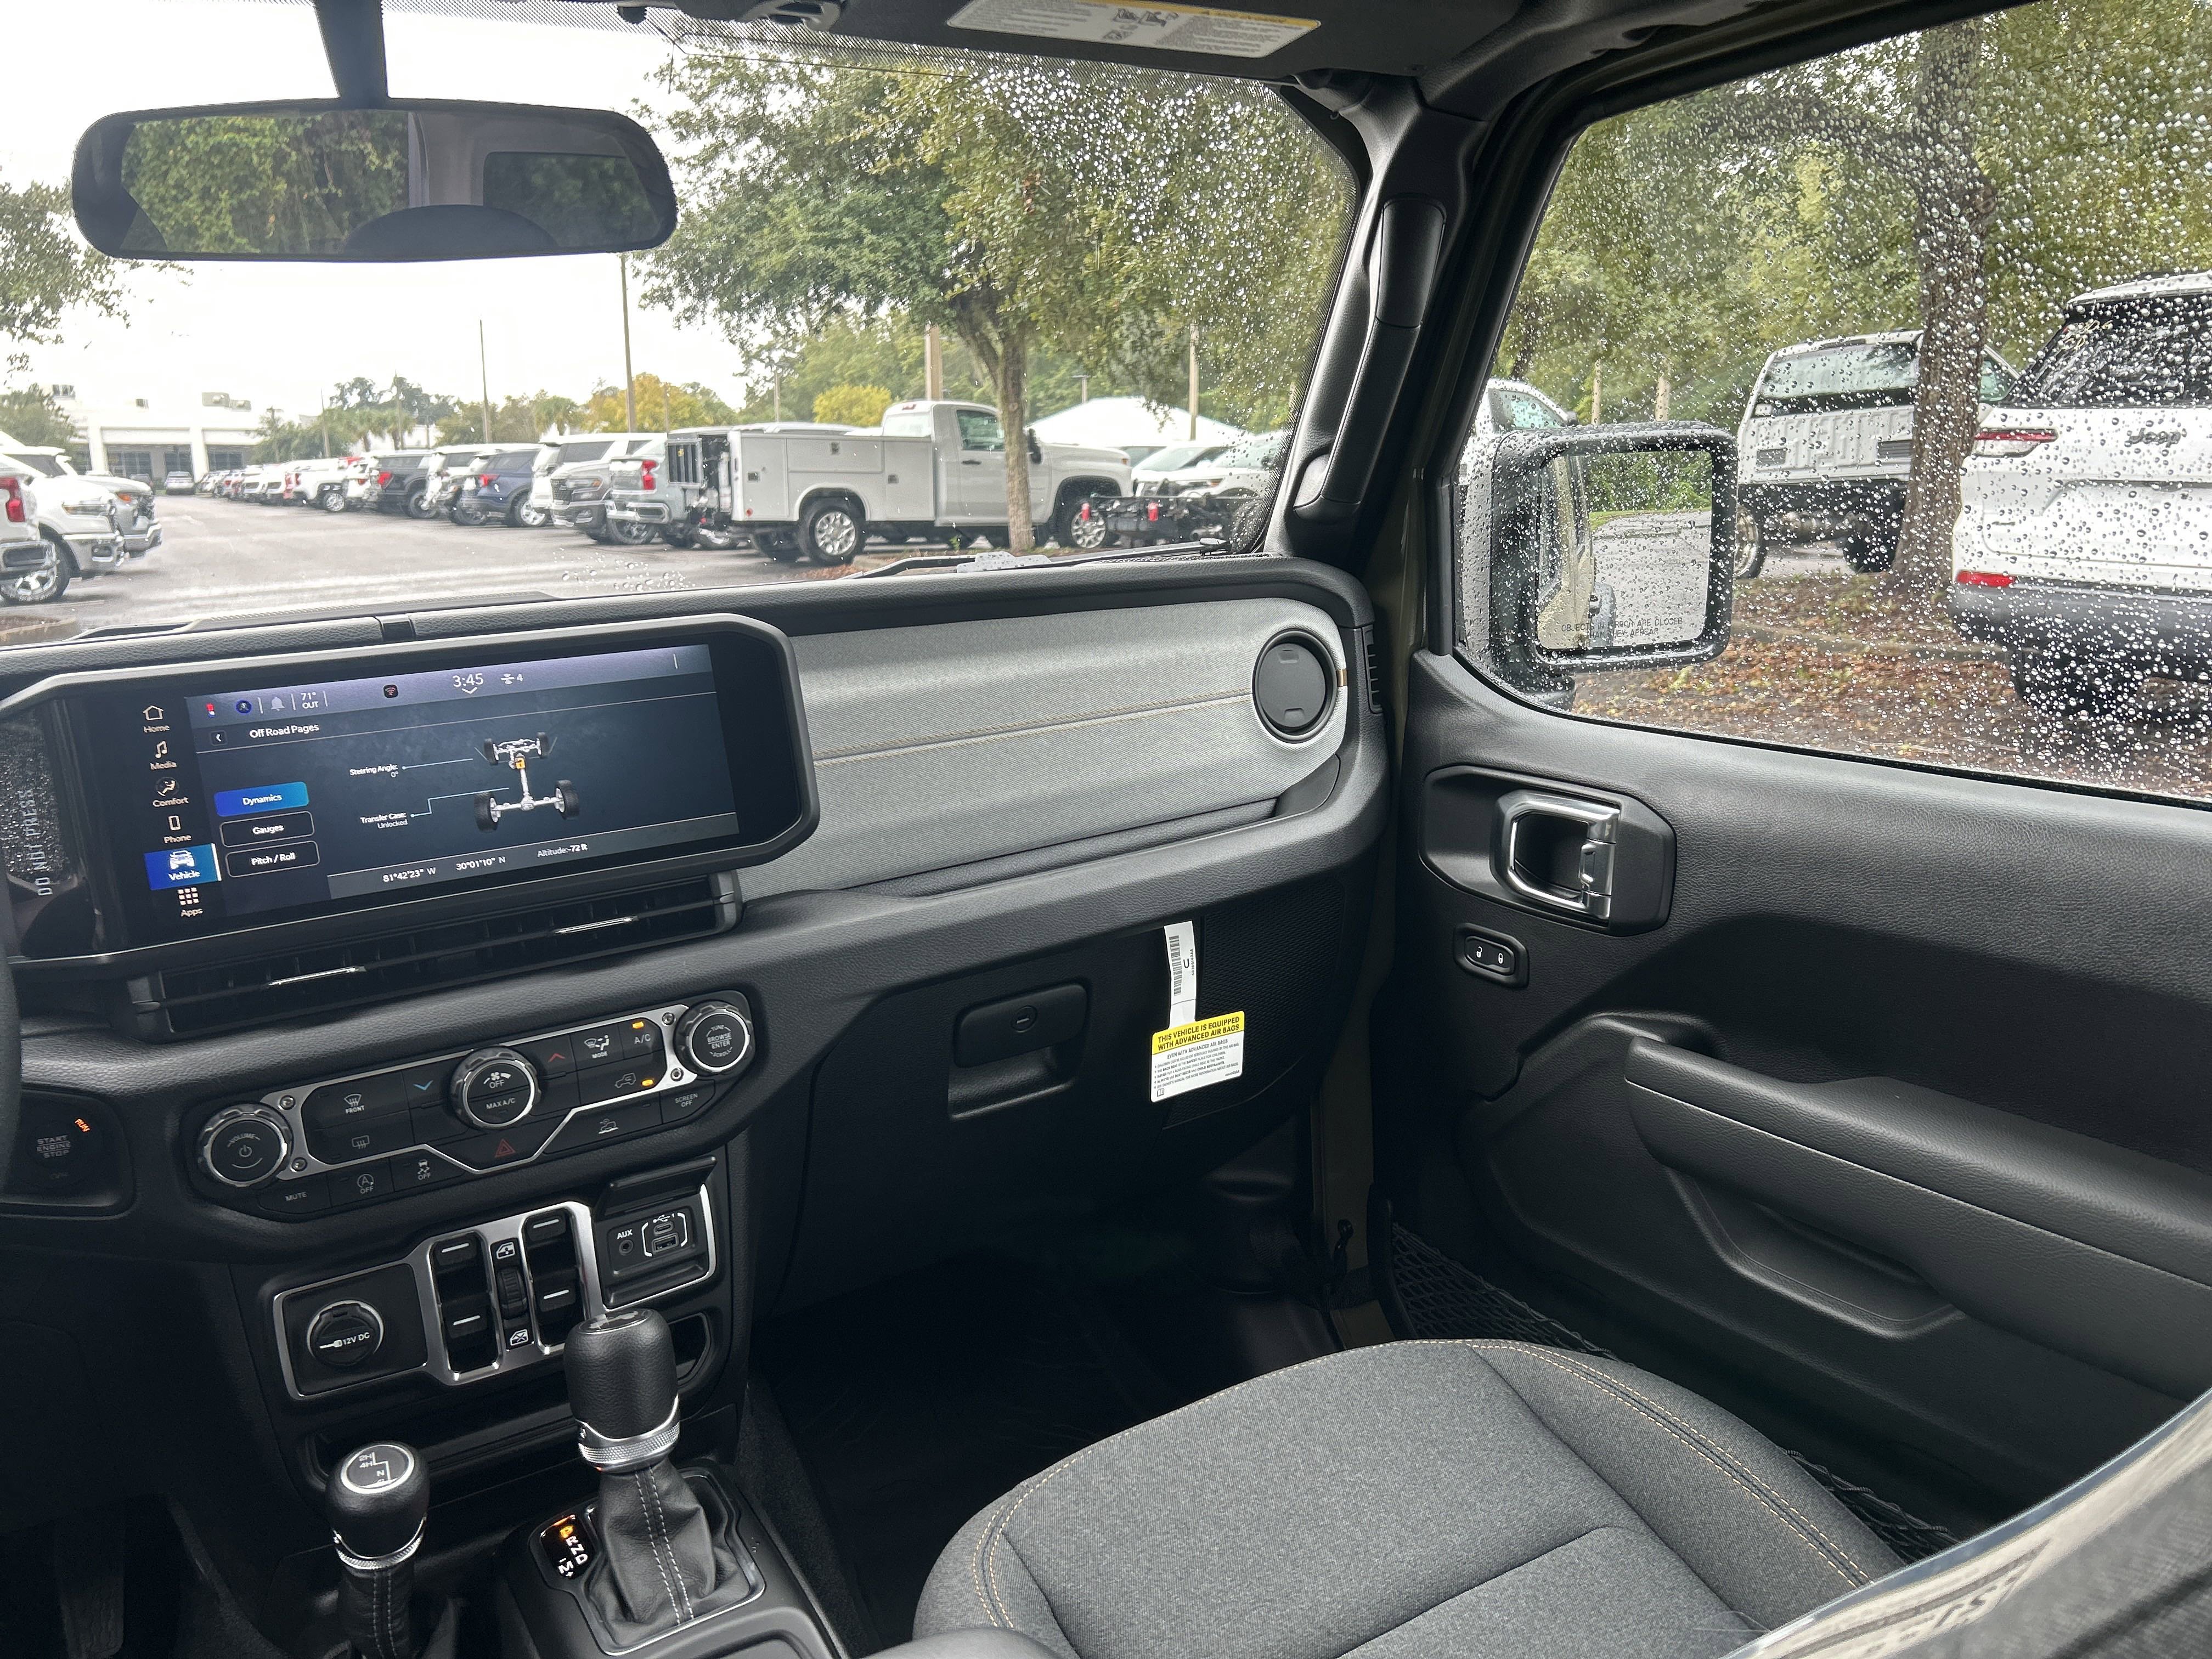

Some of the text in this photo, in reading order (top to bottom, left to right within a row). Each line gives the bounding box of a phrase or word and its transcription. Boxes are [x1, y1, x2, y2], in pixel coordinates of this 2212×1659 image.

[2129, 427, 2181, 448] Jeep
[453, 673, 484, 687] 3:45
[301, 692, 317, 701] 71°
[250, 724, 319, 738] Off Road Pages
[150, 760, 177, 770] Media
[349, 764, 398, 776] Steering Angle:
[153, 797, 189, 807] Comfort
[242, 794, 283, 806] Dynamics
[360, 814, 388, 823] Transfer
[377, 819, 408, 829] Unlocked
[252, 825, 284, 834] Gauges
[164, 834, 192, 843] Phone
[251, 852, 296, 865] Pitch / Roll
[168, 870, 201, 881] Vehicle
[35, 877, 53, 896] DO
[181, 909, 204, 917] Apps
[1183, 958, 1189, 968] U
[1158, 1034, 1172, 1043] THIS
[1173, 1026, 1199, 1037] VEHICLE
[1209, 1017, 1240, 1029] EQUIPPED
[634, 1034, 651, 1044] A/C
[707, 1032, 732, 1042] BROWSE
[1158, 1041, 1173, 1051] WITH
[1175, 1032, 1209, 1046] ADVANCED
[1223, 1024, 1239, 1034] BAGS
[712, 1040, 731, 1049] ENTER
[1189, 1043, 1209, 1052] ADVANCED
[489, 1080, 505, 1088] OFF
[675, 1093, 698, 1103] SCREEN
[345, 1105, 365, 1114] FRONT
[75, 1119, 91, 1132] RUN
[37, 1135, 68, 1144] START
[229, 1133, 256, 1143] VOLUME
[37, 1141, 71, 1152] ENGINE
[43, 1150, 70, 1158] STOP
[360, 1186, 374, 1194] OFF
[285, 1191, 307, 1201] MUTE
[617, 1229, 633, 1239] AUX
[342, 1332, 370, 1345] 12V DC
[359, 1453, 372, 1462] 2H
